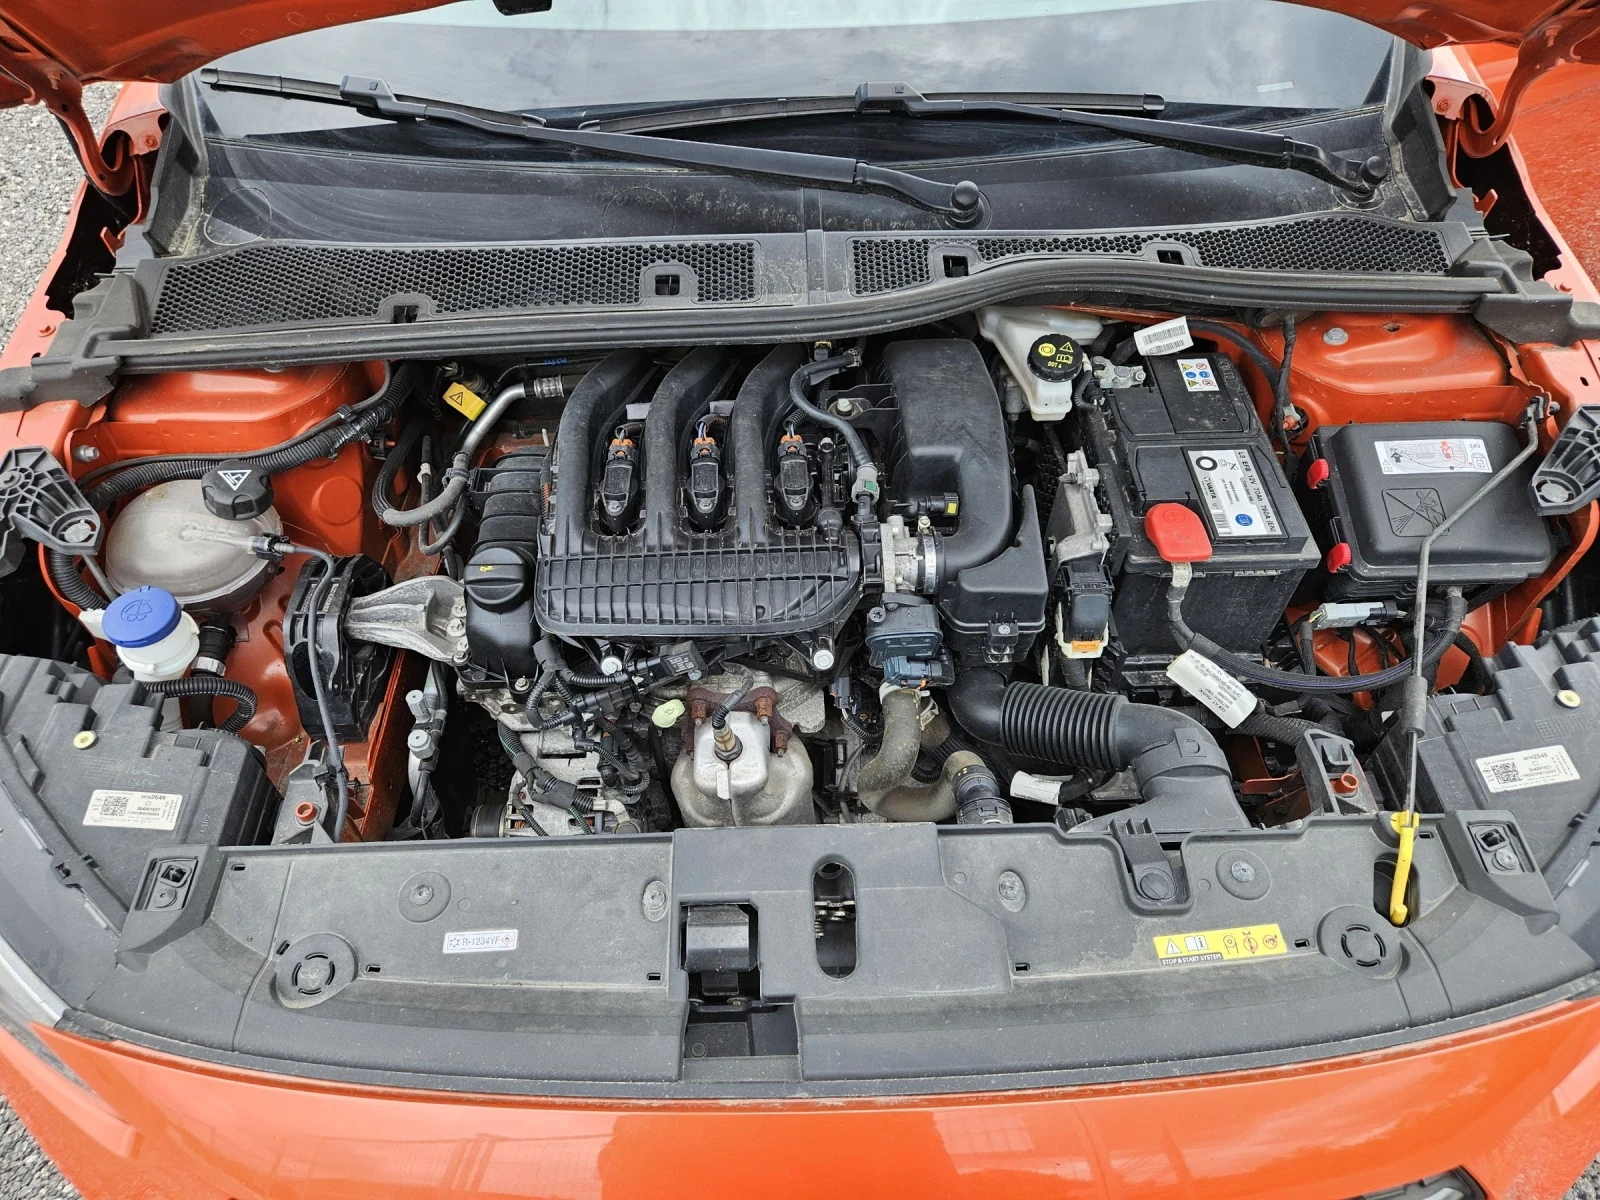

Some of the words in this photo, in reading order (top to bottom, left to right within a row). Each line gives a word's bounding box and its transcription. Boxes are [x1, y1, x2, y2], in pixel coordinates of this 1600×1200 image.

[1205, 482, 1217, 498] VARTA
[1241, 461, 1251, 471] EFB
[1247, 475, 1256, 484] 12V
[1252, 487, 1263, 501] 70Ah
[1260, 505, 1271, 519] 760A
[462, 936, 500, 945] R-1234YF
[1200, 953, 1221, 961] SYSTEM
